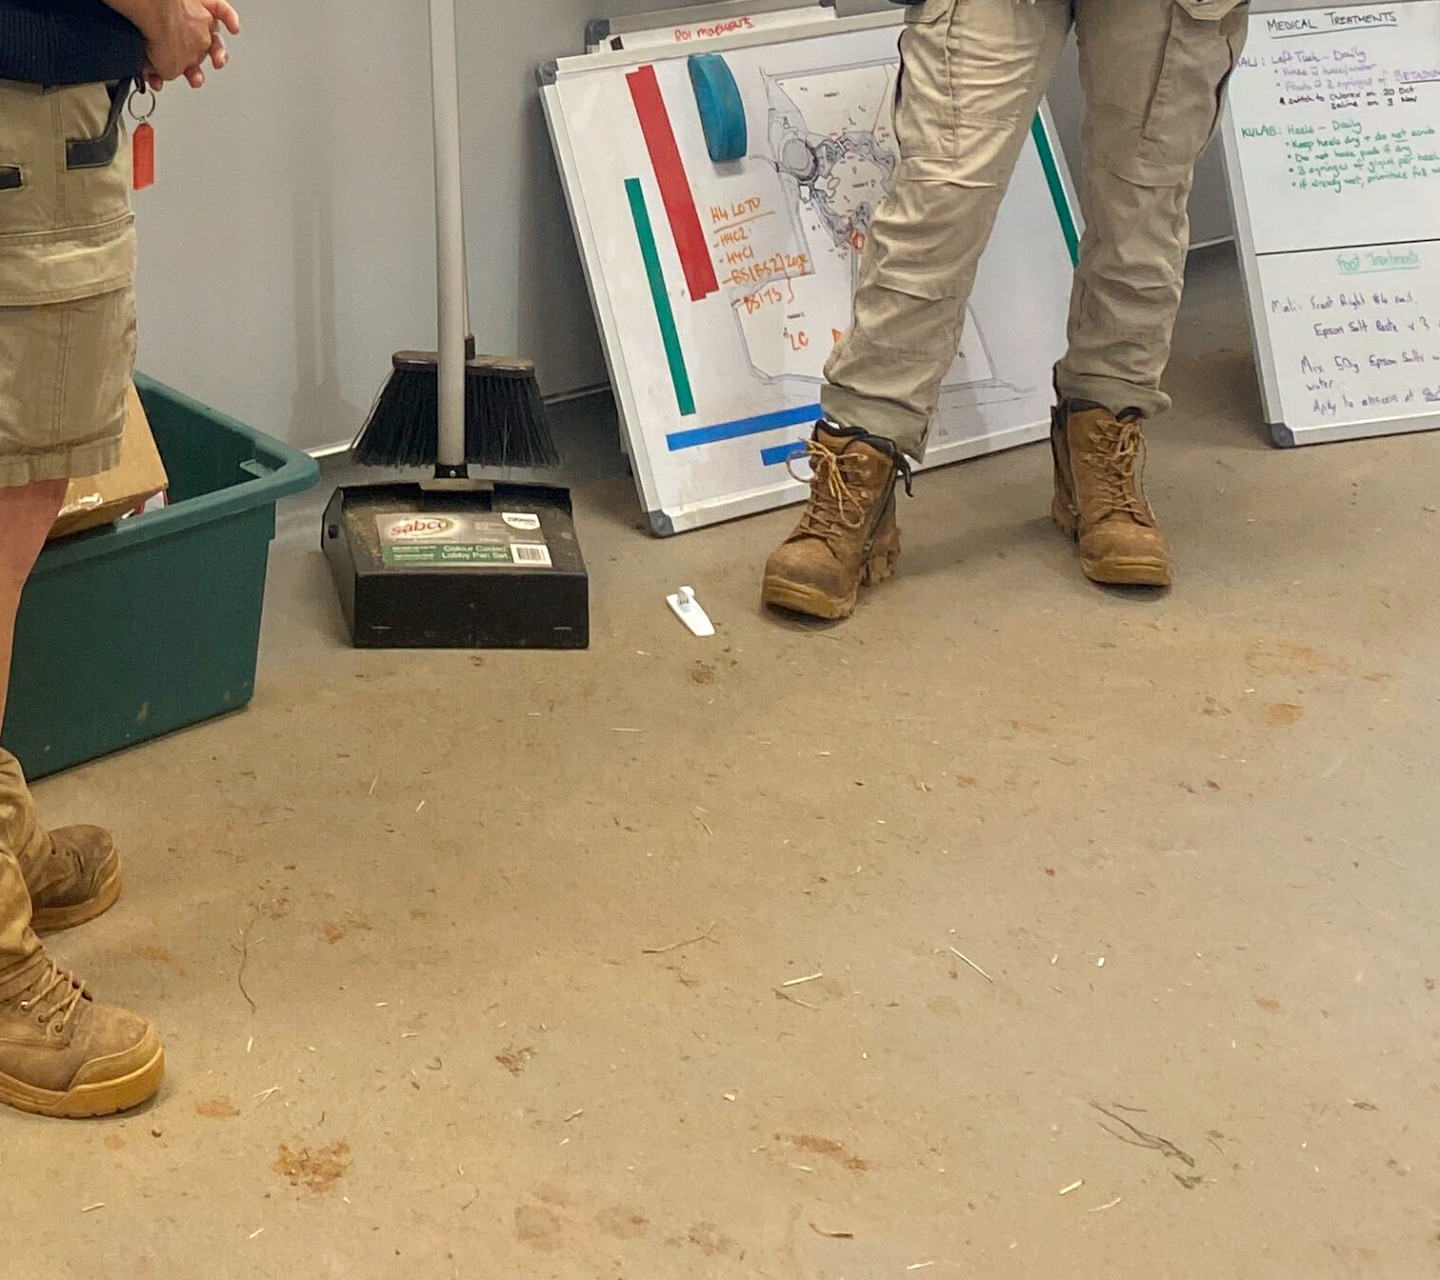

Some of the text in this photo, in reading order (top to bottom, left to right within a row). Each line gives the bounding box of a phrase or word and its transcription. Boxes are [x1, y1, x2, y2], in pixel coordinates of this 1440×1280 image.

[1267, 11, 1397, 32] MEDICAL TREATMENTS
[390, 517, 450, 537] sabco
[441, 552, 471, 561] Lobby
